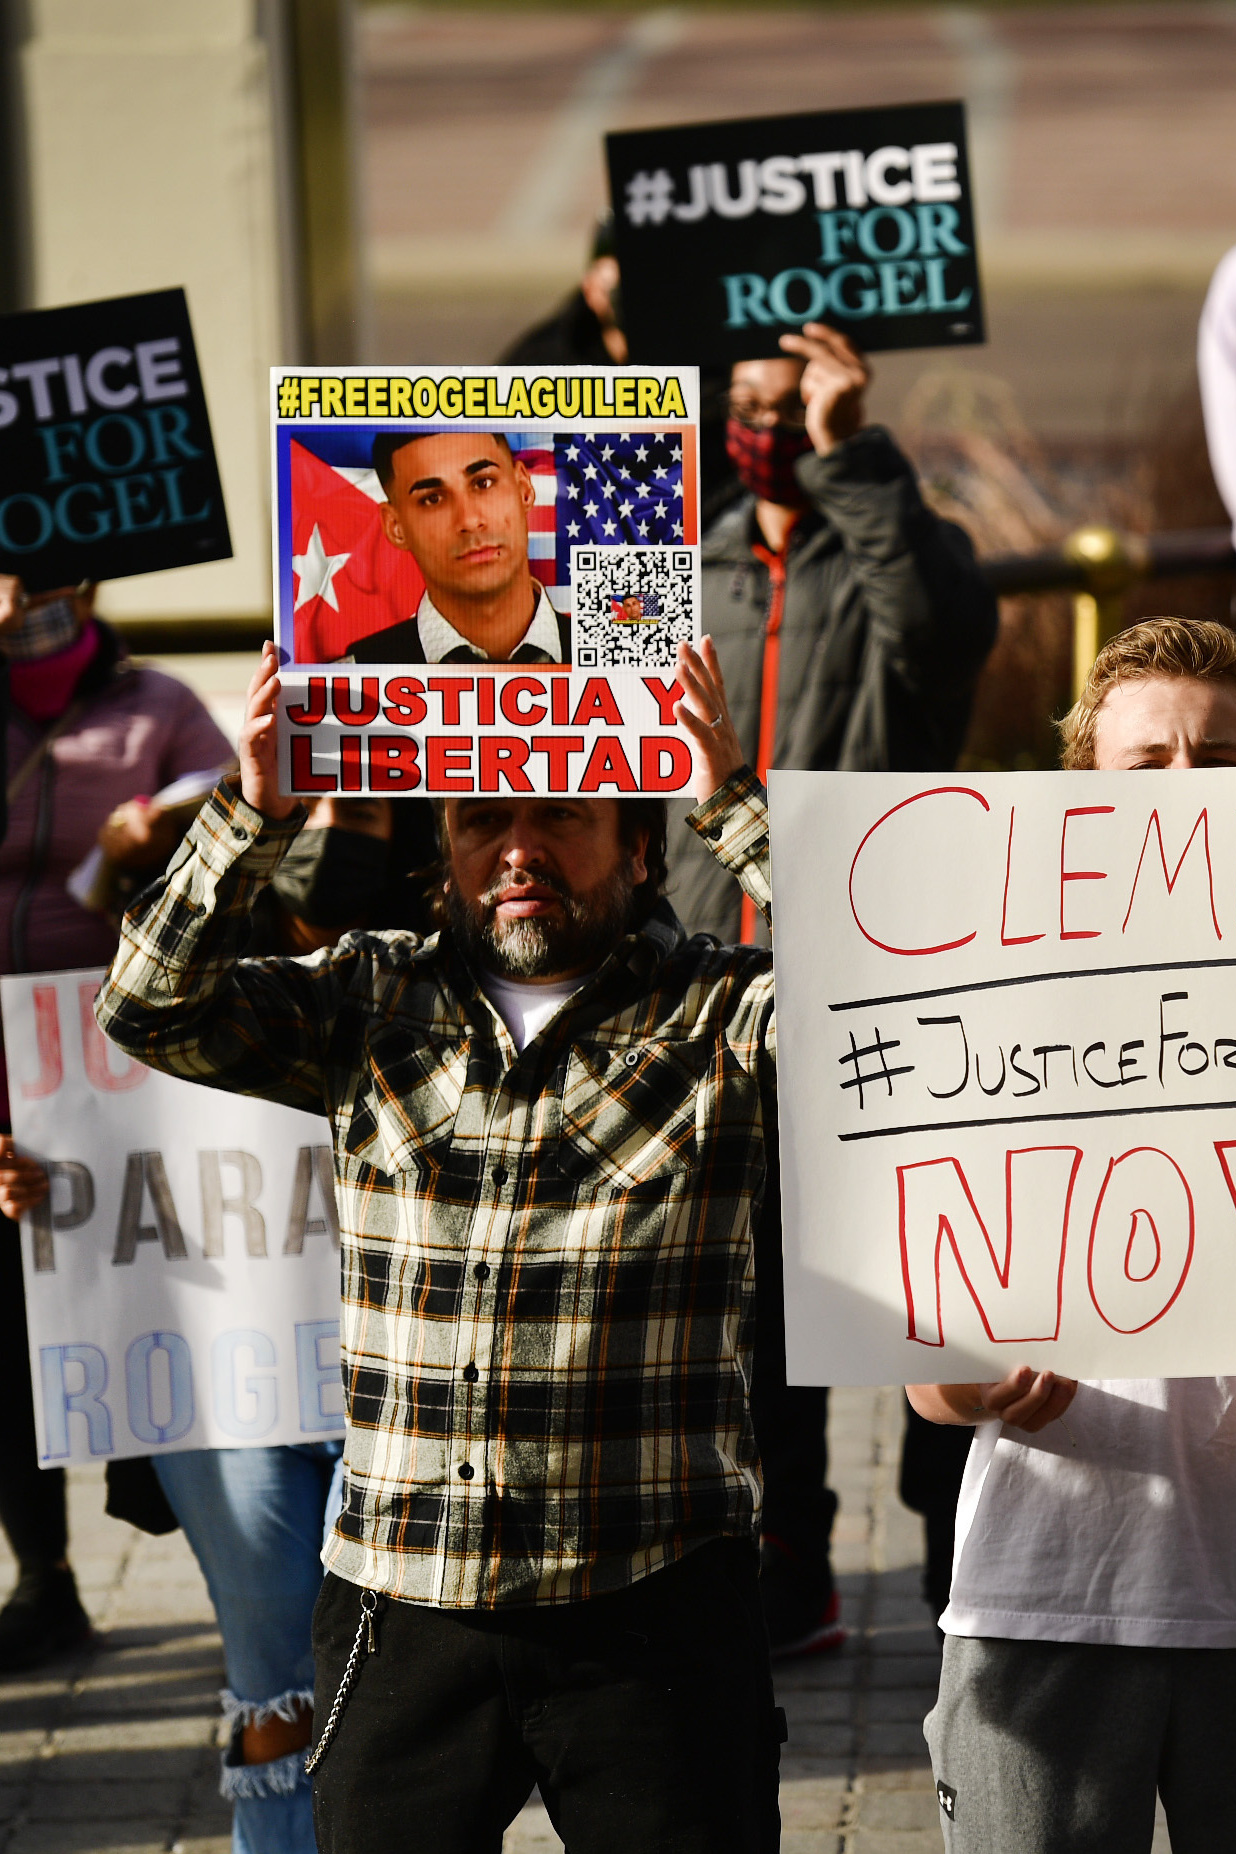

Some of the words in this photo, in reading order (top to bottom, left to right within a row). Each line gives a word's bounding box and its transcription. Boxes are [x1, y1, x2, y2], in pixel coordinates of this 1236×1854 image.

[626, 143, 961, 226] #JUSTICE
[816, 202, 967, 264] FOR
[723, 259, 971, 329] ROGEL
[278, 377, 687, 418] #FREEROGELAGUILERA
[38, 404, 201, 484] FOR
[286, 677, 624, 726] JUSTICIA
[641, 677, 686, 726] Y
[290, 735, 693, 793] LIBERTAD
[31, 1145, 340, 1272] PARA
[38, 1320, 346, 1460] ROGE
